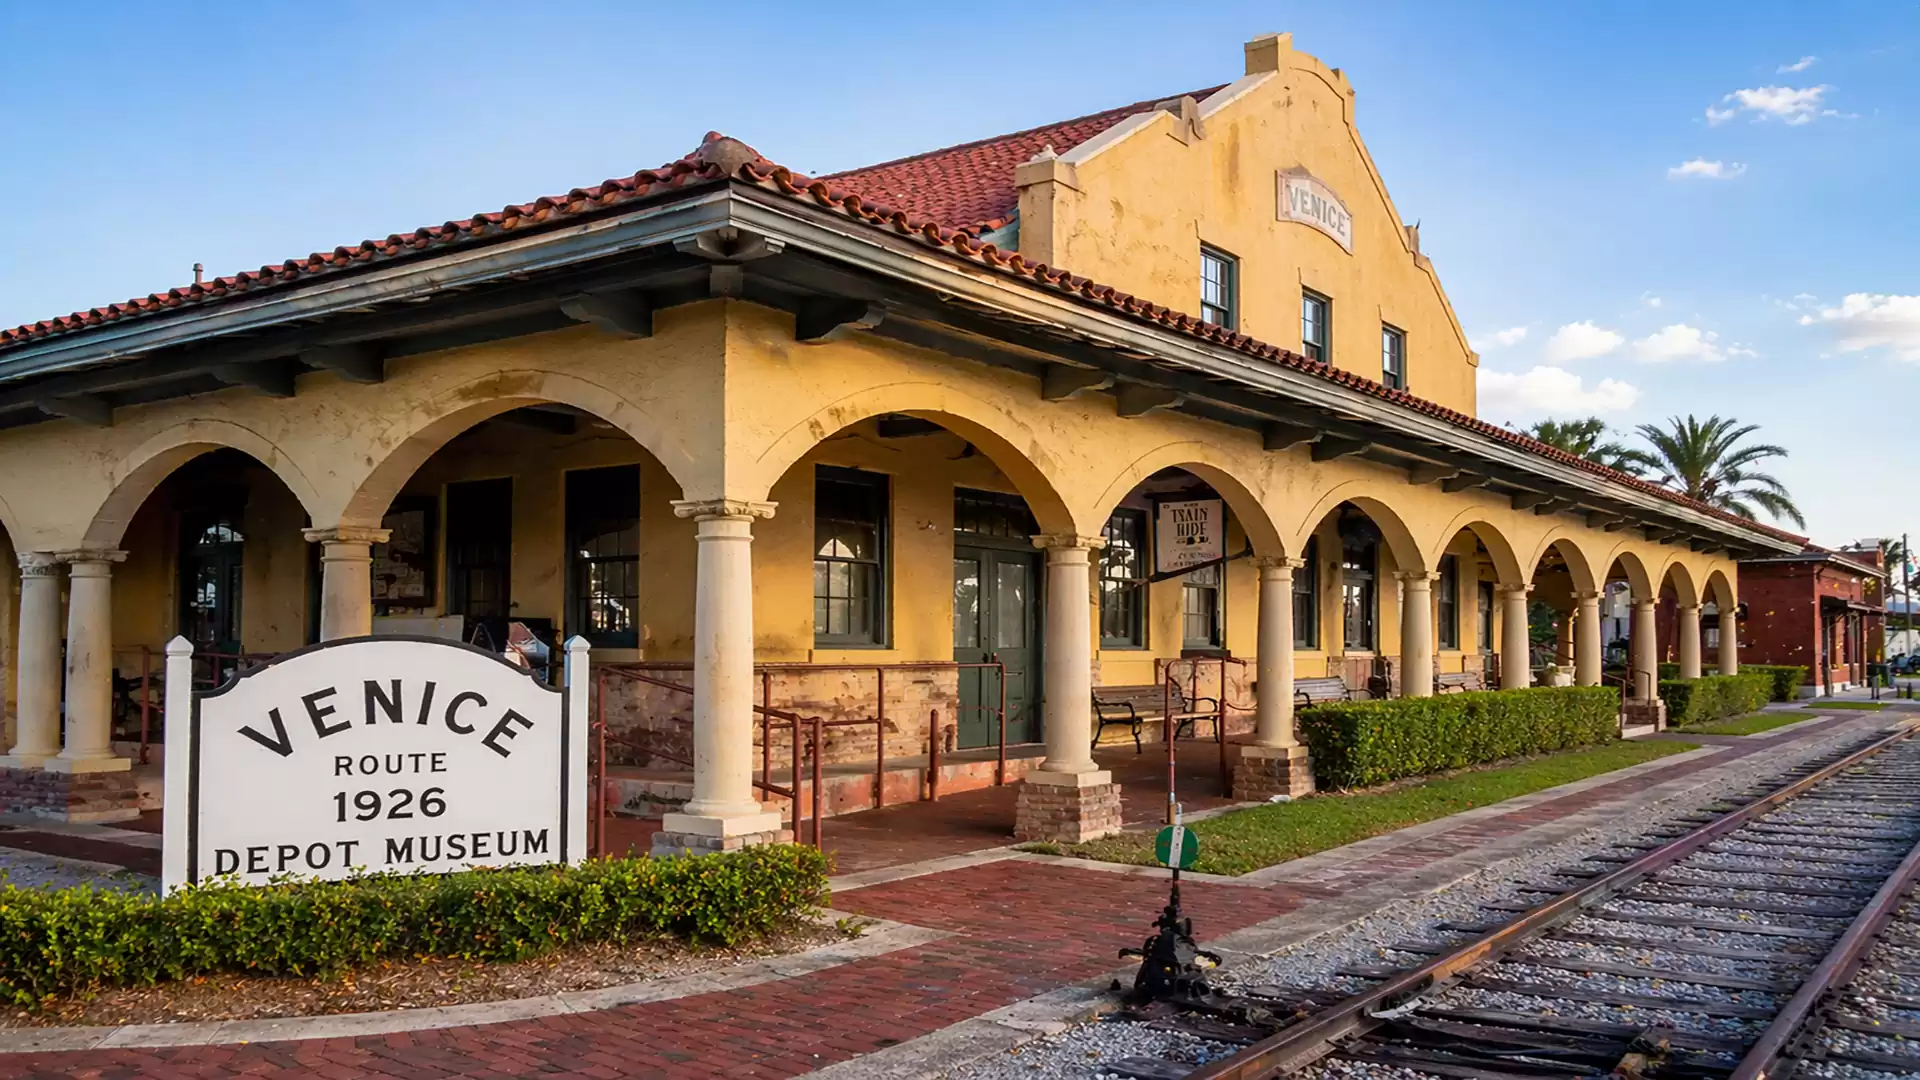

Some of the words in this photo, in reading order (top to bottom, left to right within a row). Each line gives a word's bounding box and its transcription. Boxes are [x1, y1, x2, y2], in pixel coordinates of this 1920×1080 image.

[1287, 185, 1346, 237] VENICE
[237, 678, 534, 758] VENICE
[334, 752, 447, 776] ROUTE
[333, 787, 447, 822] 1926
[214, 840, 359, 876] DEPOT
[385, 828, 549, 865] MUSEUM
